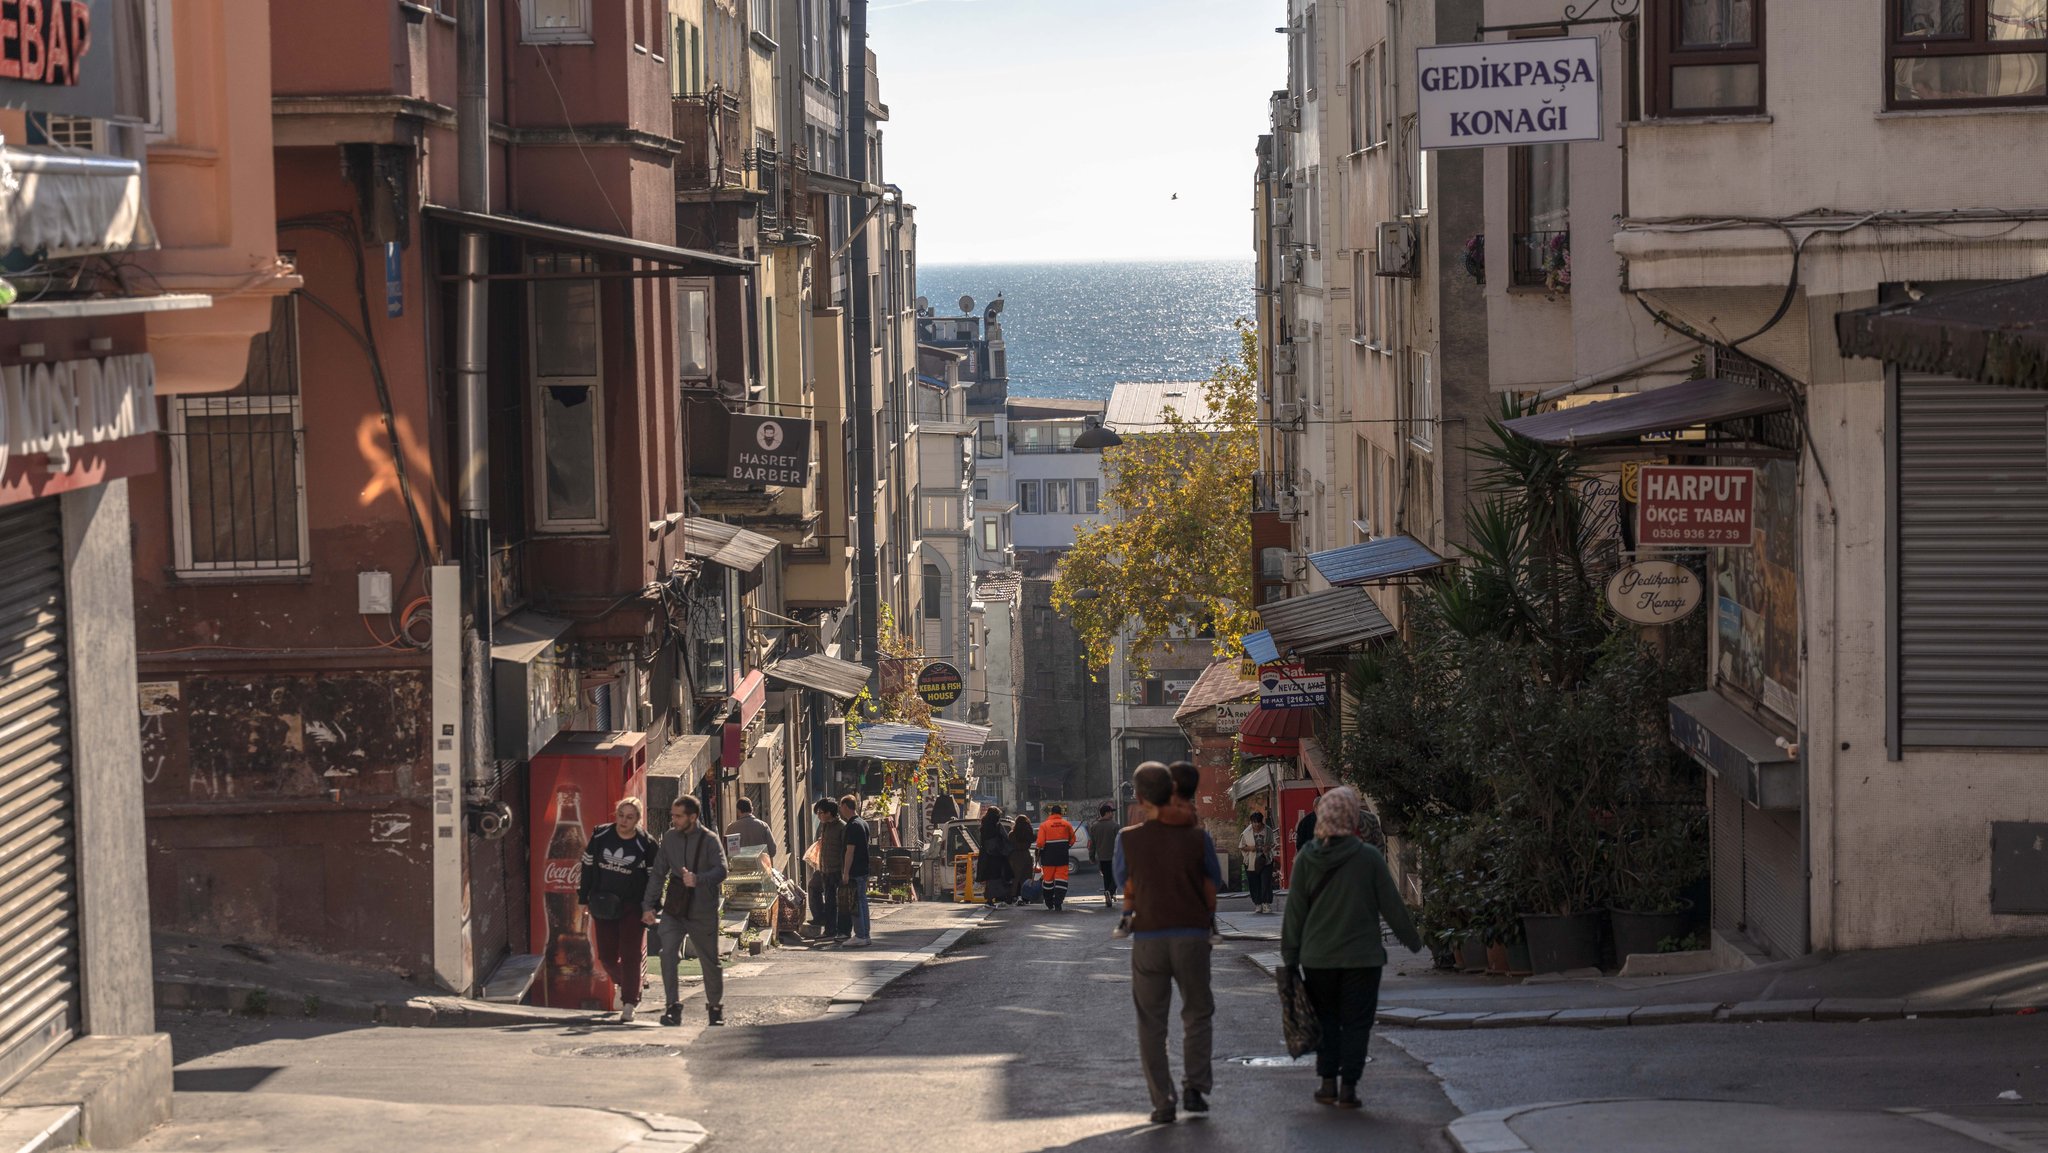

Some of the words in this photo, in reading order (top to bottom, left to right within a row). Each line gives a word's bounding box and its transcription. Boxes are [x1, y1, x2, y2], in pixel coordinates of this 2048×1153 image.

[1421, 56, 1594, 92] GEDİKPAŞA
[1450, 98, 1568, 137] KONAĞI
[739, 452, 797, 467] HASRET
[733, 465, 800, 483] BARBER
[1646, 475, 1747, 501] HARPUT
[1646, 504, 1688, 526] ÖKÇE
[1694, 508, 1746, 523] TABAN
[1652, 528, 1681, 539] 0536
[1683, 529, 1705, 539] 936
[1708, 529, 1722, 539] 27
[1725, 529, 1740, 540] 39
[1618, 568, 1690, 595] Gedikpaşa
[919, 683, 941, 692] KEBAB
[940, 683, 947, 691] &
[946, 682, 962, 690] FISH
[927, 691, 955, 701] HOUSE
[544, 862, 582, 884] Coca-Co
[598, 862, 633, 875] adidas
